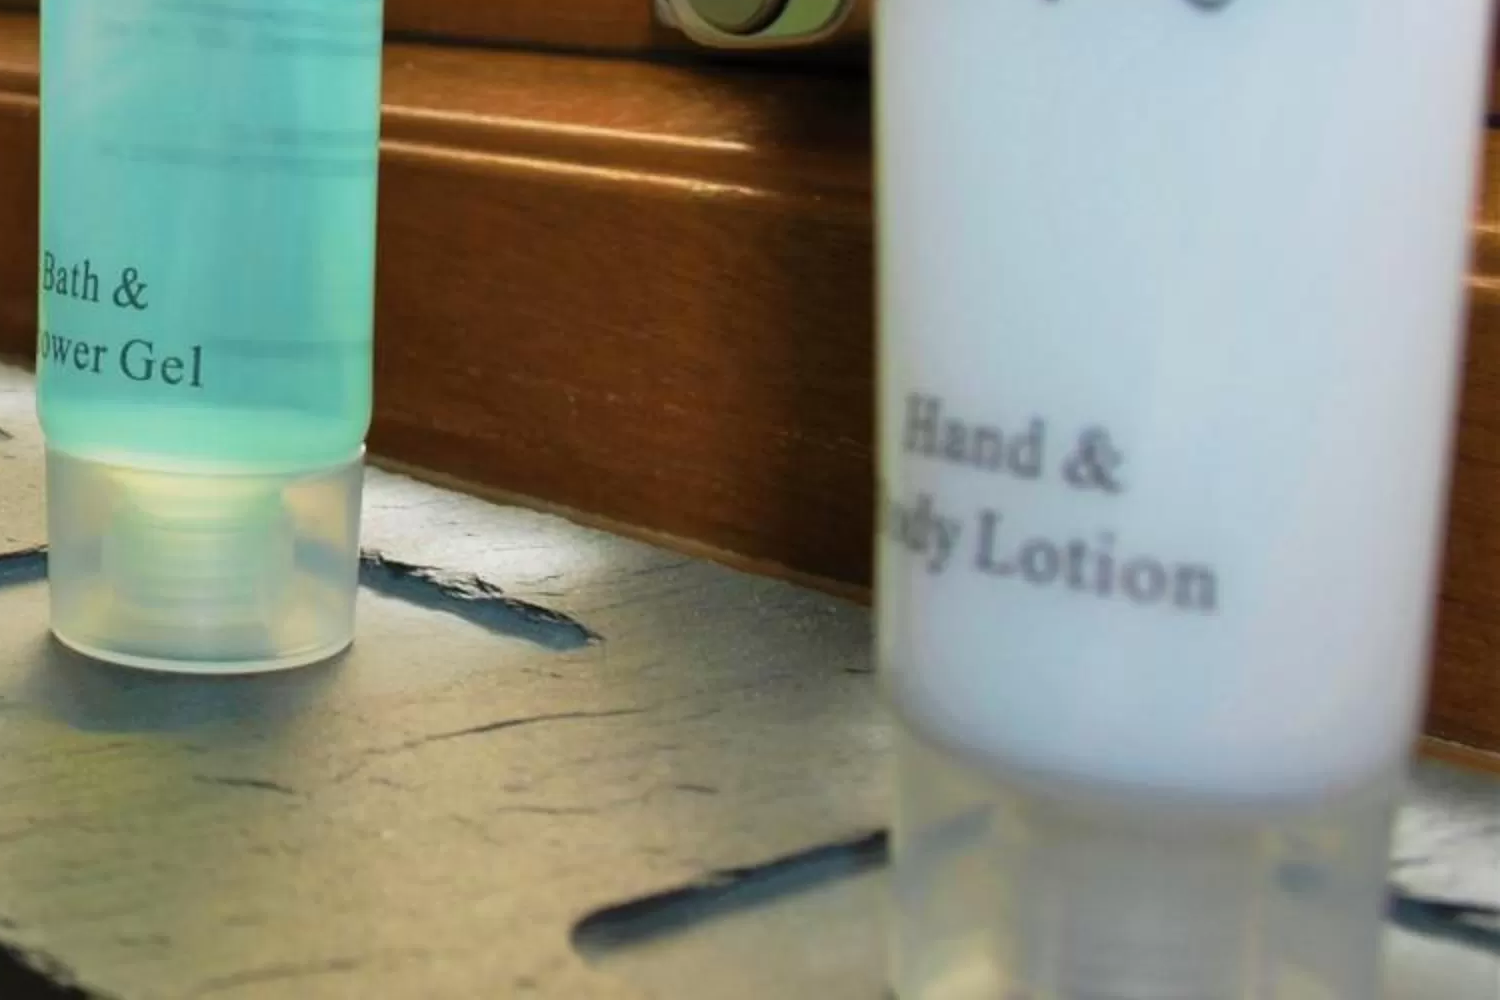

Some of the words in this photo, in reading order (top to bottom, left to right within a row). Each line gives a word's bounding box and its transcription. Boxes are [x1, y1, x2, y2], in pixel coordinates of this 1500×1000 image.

[42, 251, 100, 303] Bath
[112, 267, 148, 311] &
[40, 331, 108, 374] ower
[119, 339, 203, 388] Gel
[904, 394, 1043, 480] Hand
[1061, 424, 1127, 495] &
[975, 509, 1217, 612] Lotion
